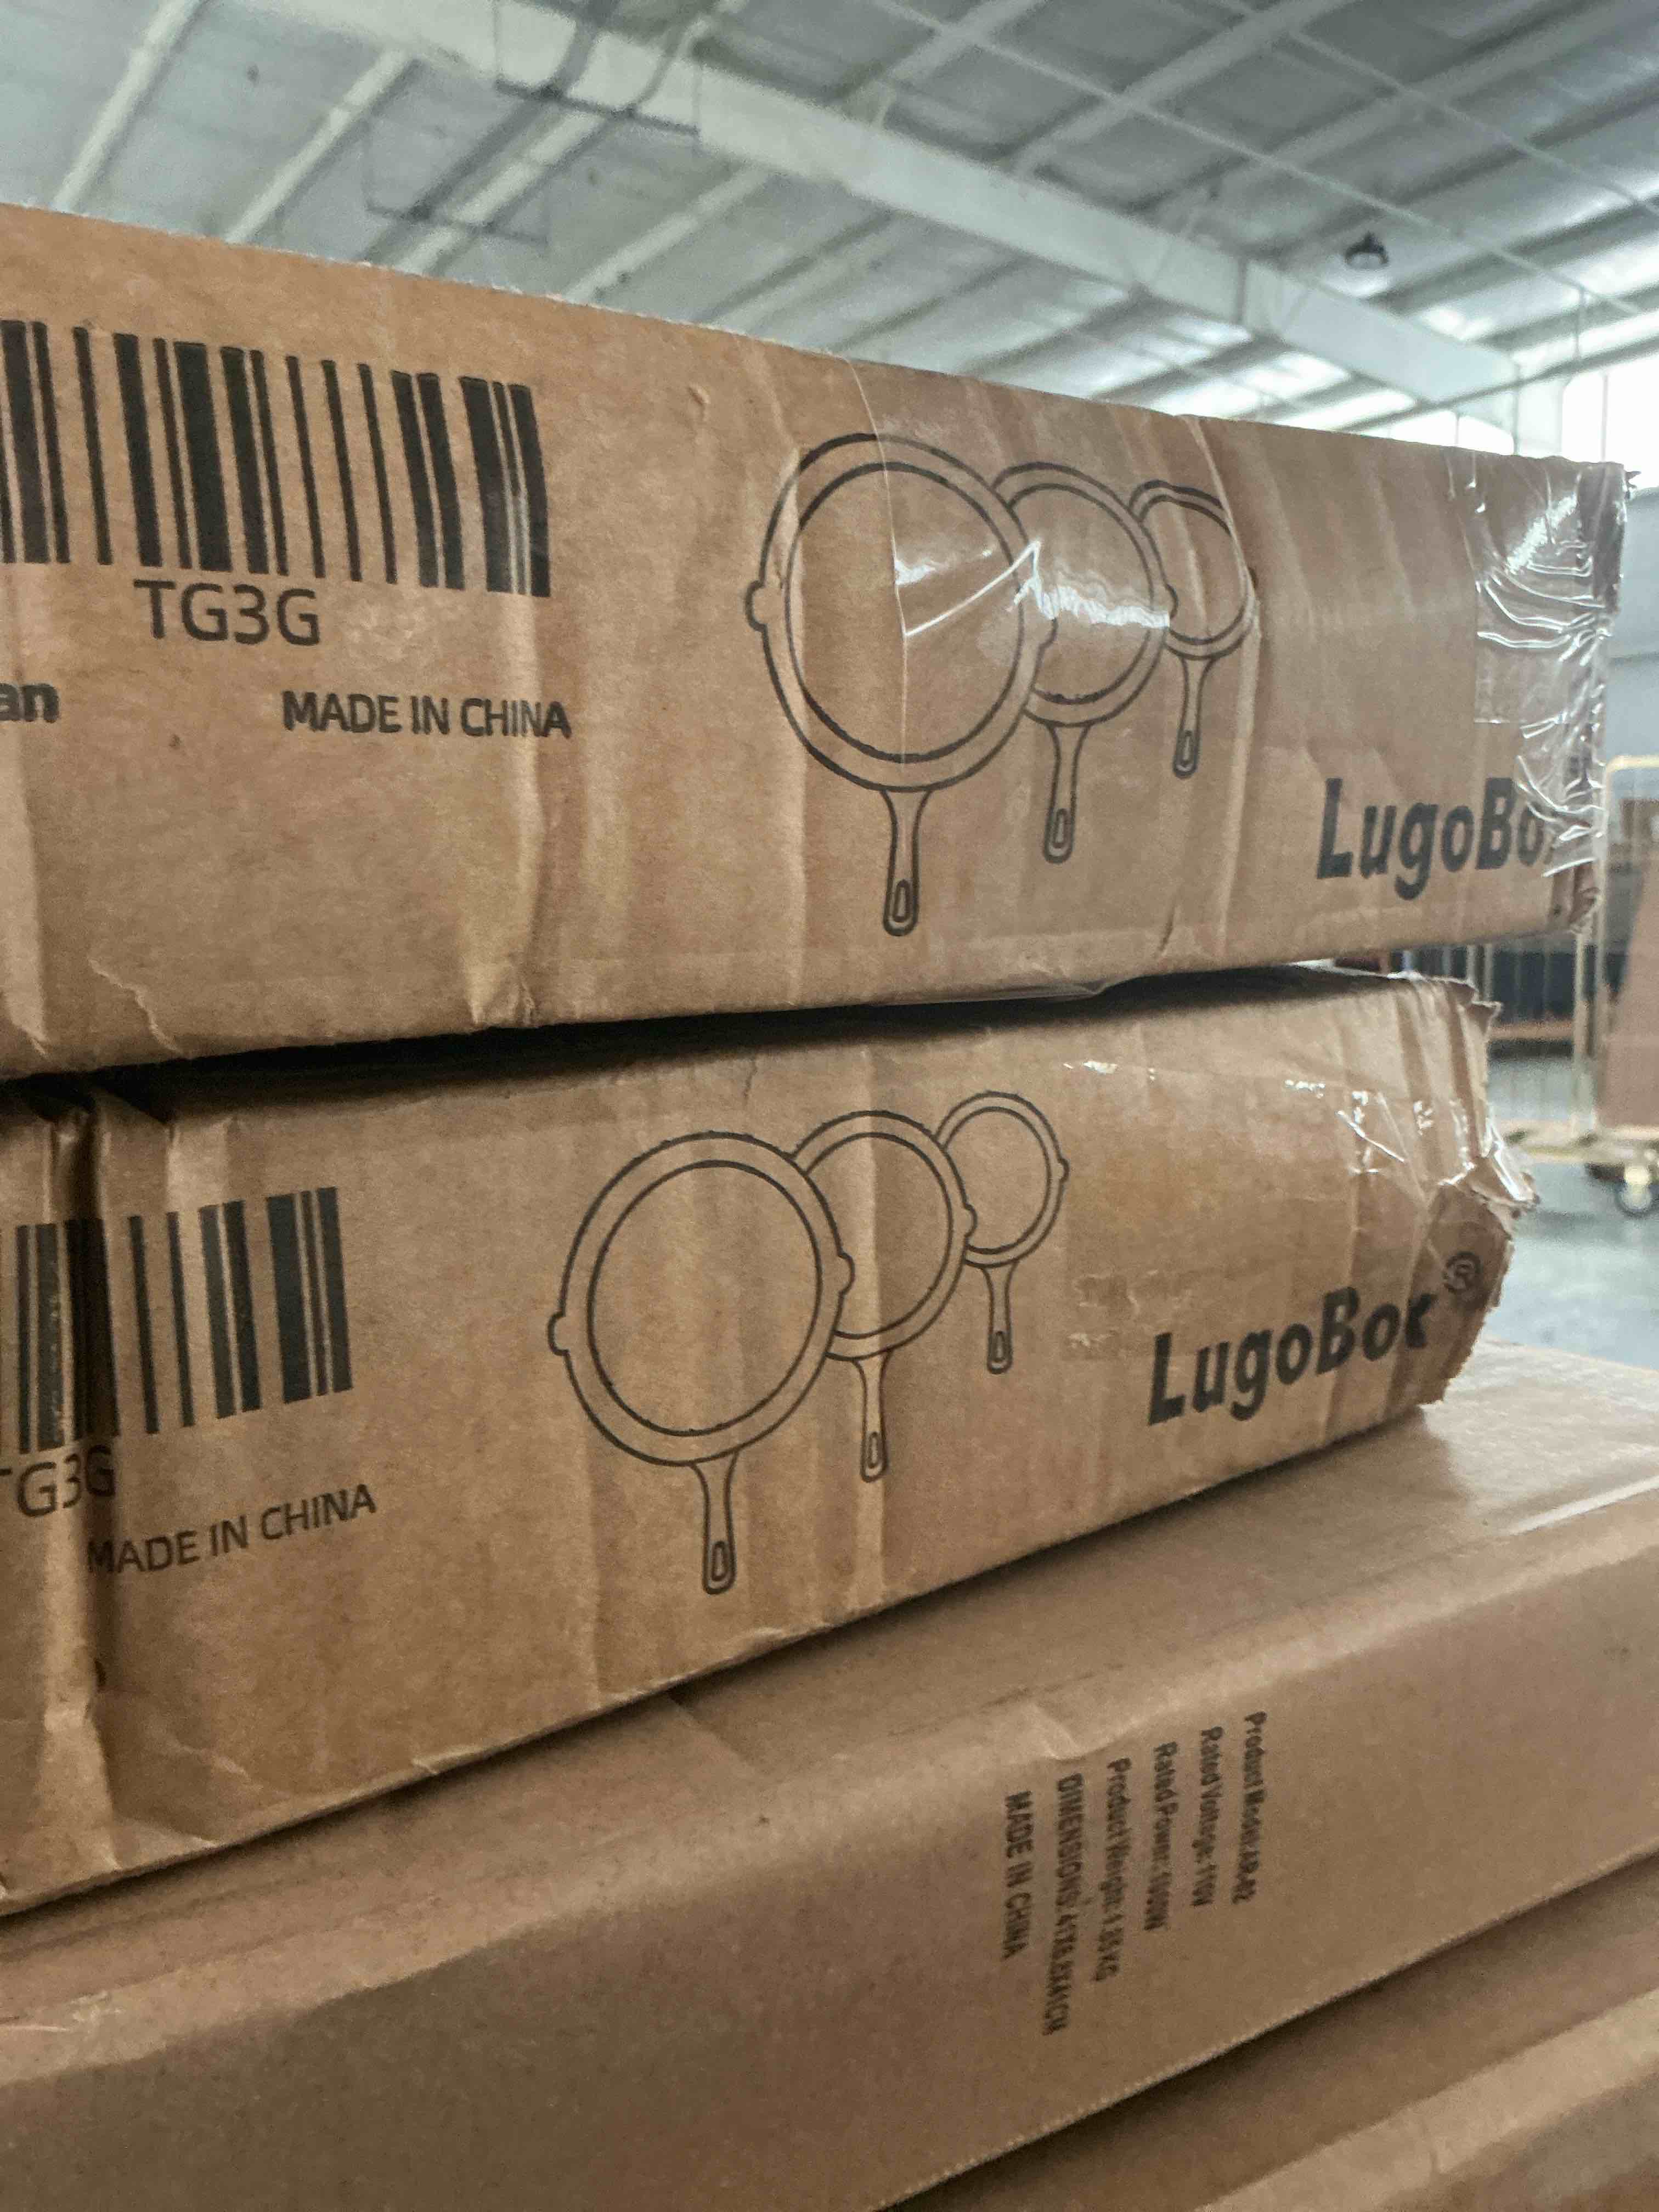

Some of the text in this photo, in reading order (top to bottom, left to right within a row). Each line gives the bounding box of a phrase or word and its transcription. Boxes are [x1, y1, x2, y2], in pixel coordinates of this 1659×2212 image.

[133, 578, 321, 647] TG3G
[281, 690, 572, 740] MADE IN CHINA
[1317, 777, 1555, 901] LugoBo
[87, 1483, 377, 1573] MADE IN CHINA
[1153, 1741, 1178, 1801] Rated
[1200, 1725, 1223, 1786] Rated
[1243, 1711, 1267, 1787] Product
[1105, 1757, 1131, 1837] Product
[1000, 1790, 1034, 1962] MADE IN CHINA
